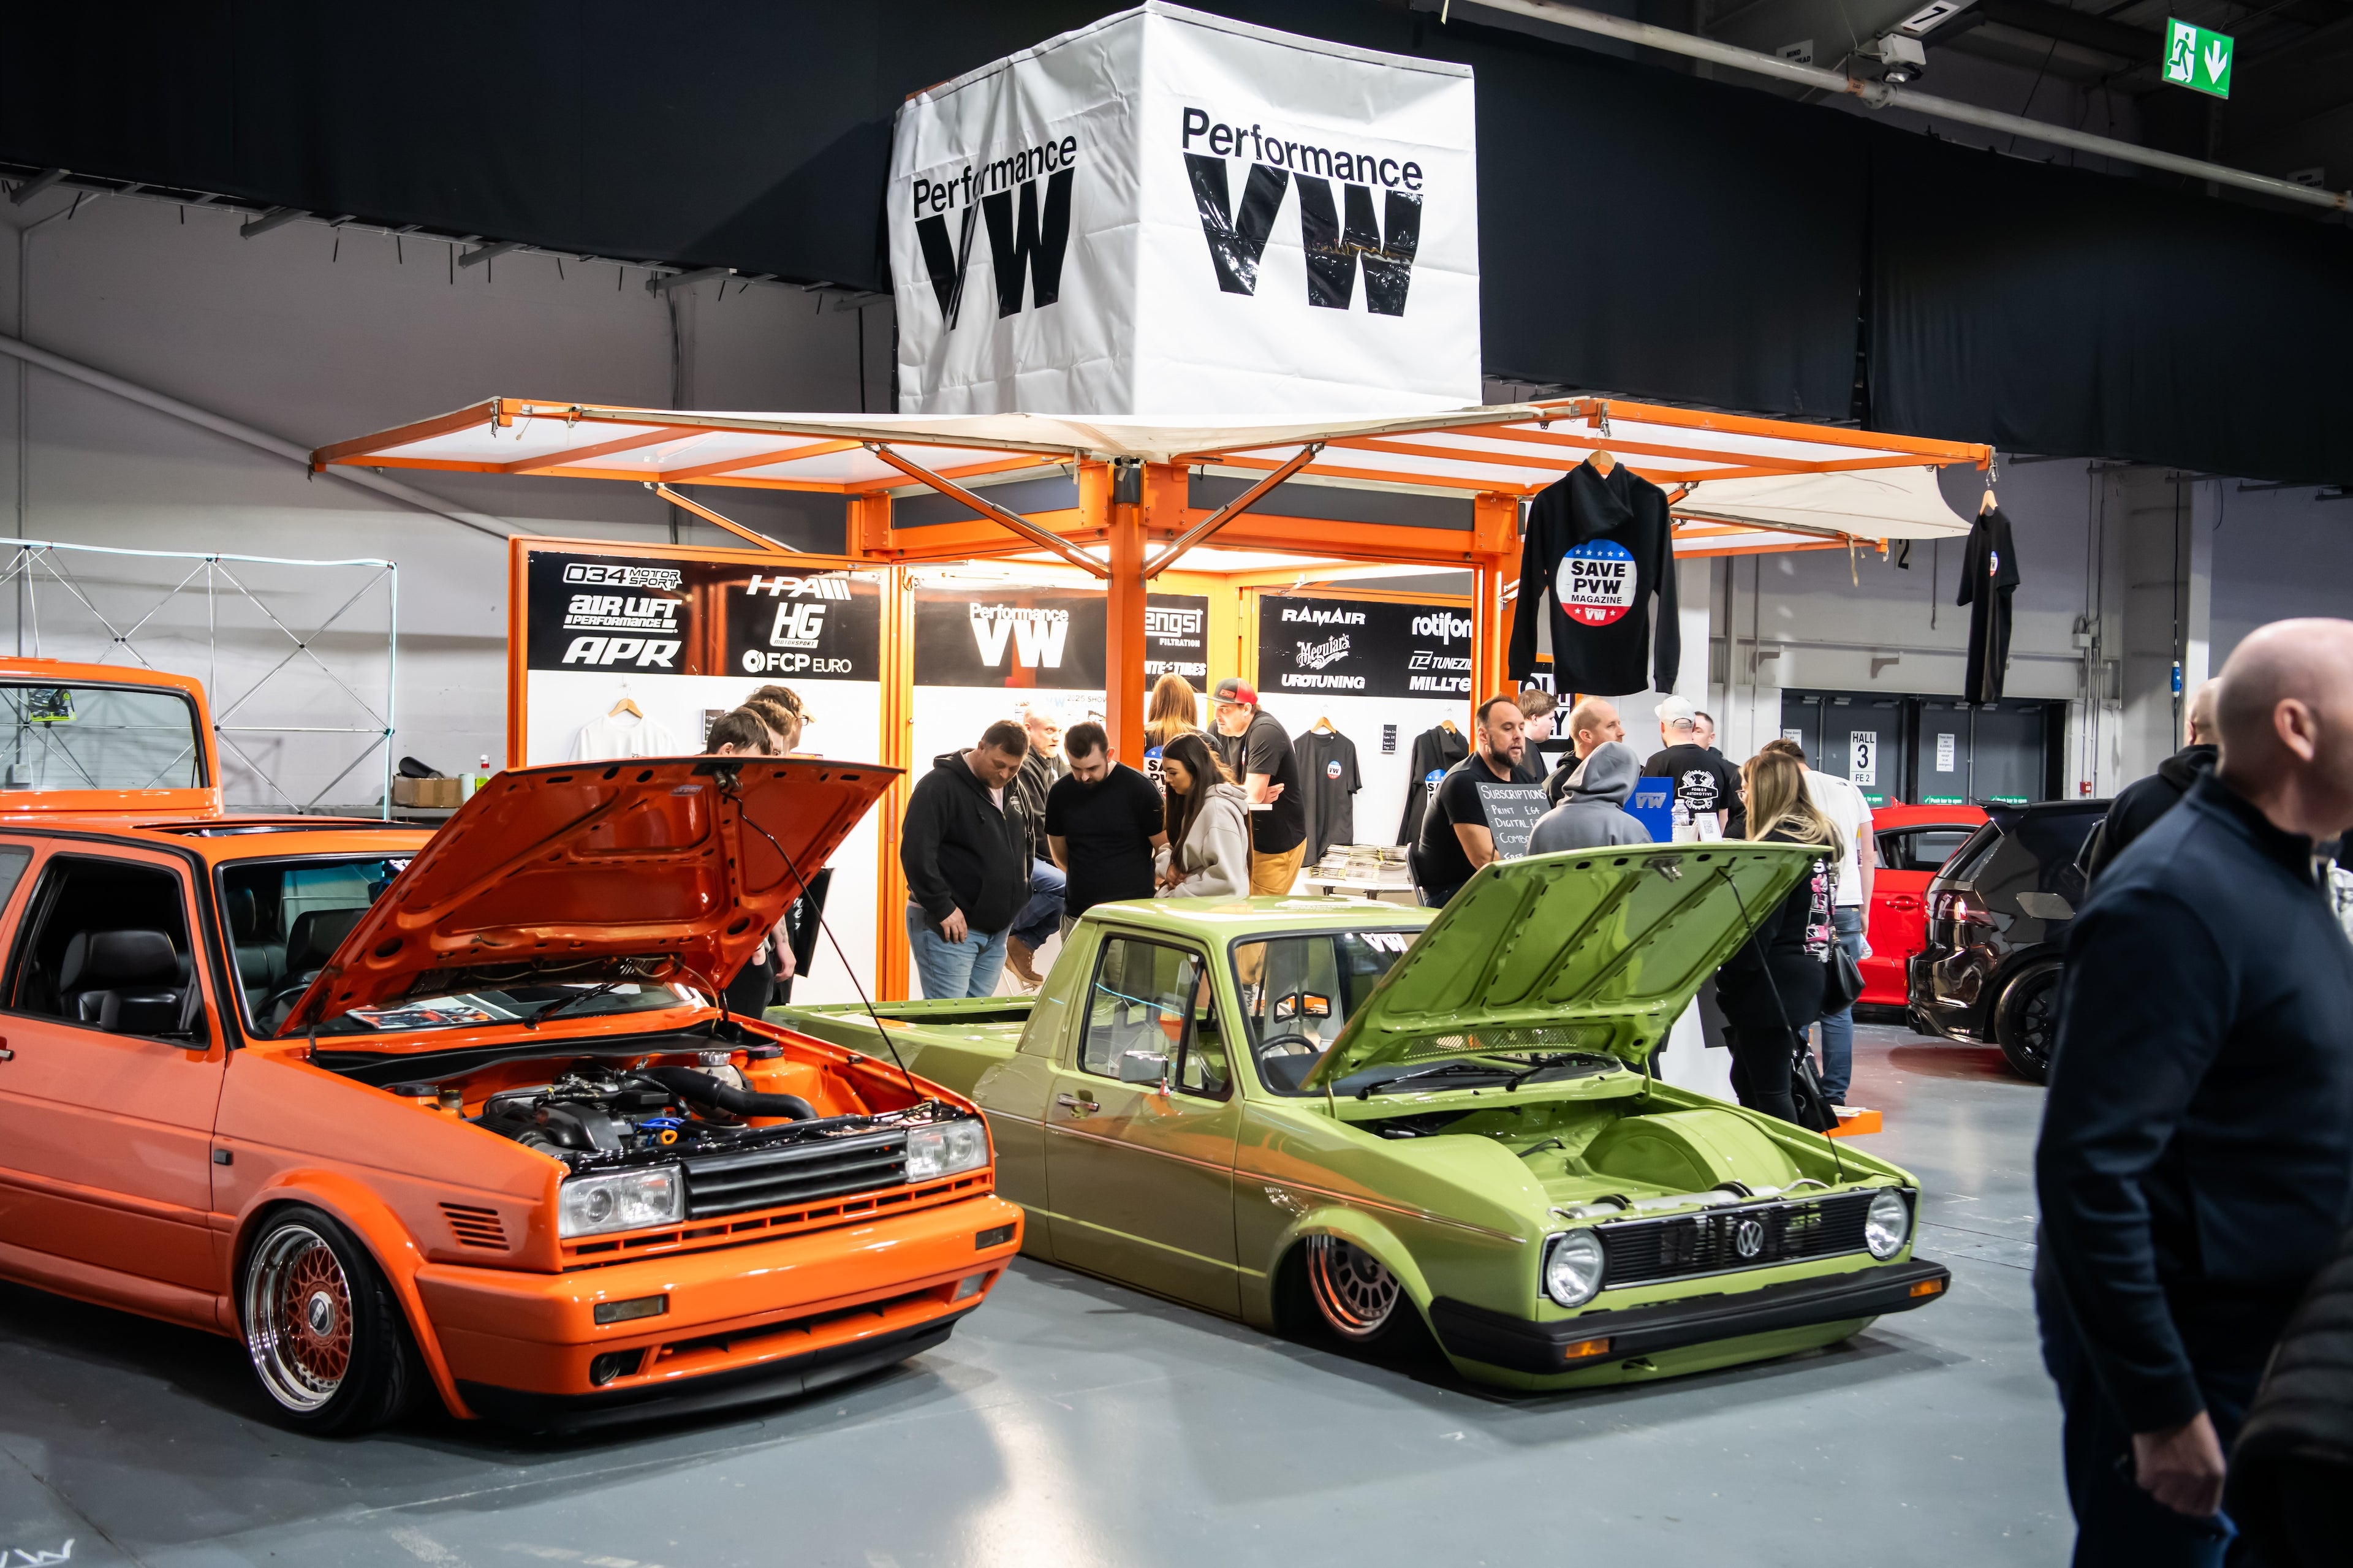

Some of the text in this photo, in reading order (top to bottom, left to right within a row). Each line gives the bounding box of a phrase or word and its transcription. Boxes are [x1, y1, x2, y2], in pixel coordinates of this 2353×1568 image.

[1912, 6, 1949, 24] 7
[1786, 49, 1801, 58] MIND
[1183, 107, 1423, 191] Performance
[914, 135, 1077, 218] Performance
[1183, 152, 1423, 317] VW
[915, 166, 1075, 336] VW
[1898, 539, 1909, 569] 2
[566, 566, 626, 583] 034
[629, 569, 678, 580] MOTOR
[1571, 561, 1626, 577] SAVE
[629, 577, 678, 587] SPORT
[1574, 578, 1621, 594] PVW
[624, 597, 682, 618] LIFT
[1571, 595, 1623, 604] MAGAZINE
[969, 602, 1069, 621] Performance
[1282, 605, 1366, 626] RAMAIR
[772, 602, 827, 640] HG
[1145, 608, 1203, 637] engst
[1412, 612, 1472, 645] rotifor
[970, 618, 1069, 668] VW
[1159, 638, 1200, 647] FILTRATION
[562, 637, 682, 667] APR
[767, 653, 852, 673] FCP EURO
[1281, 674, 1366, 689] UROTUNING
[1852, 733, 1874, 743] HALL
[1857, 744, 1868, 768] 3
[1481, 785, 1547, 800] SUBSCRIPTIONS
[1635, 793, 1666, 808] VW
[1491, 805, 1515, 815] PRINT
[1495, 817, 1529, 828] DIGITAL
